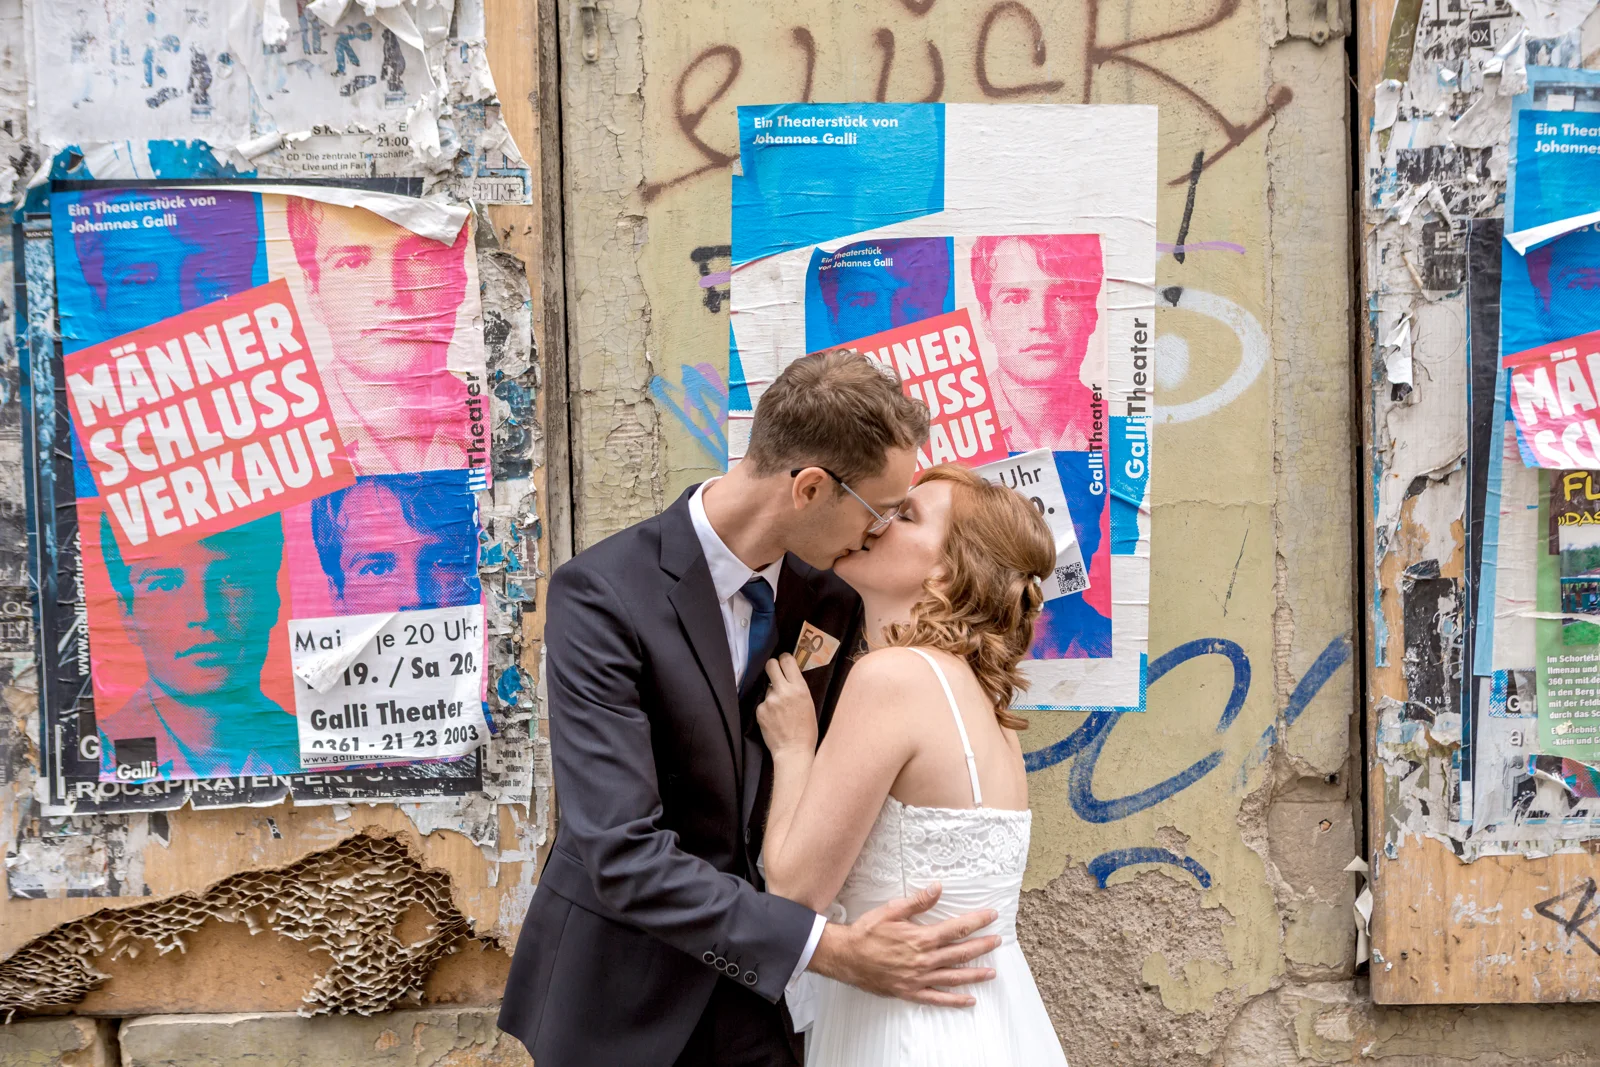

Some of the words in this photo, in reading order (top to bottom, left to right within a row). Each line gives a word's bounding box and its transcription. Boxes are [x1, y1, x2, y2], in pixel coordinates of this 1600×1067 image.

[754, 118, 773, 128] Ein
[777, 115, 868, 128] Theaterstück
[873, 118, 899, 128] von
[1535, 123, 1557, 135] Ein
[377, 137, 409, 147] 21:00
[753, 133, 818, 145] Johannes
[823, 133, 857, 145] Galli
[323, 163, 338, 171] und
[68, 203, 91, 217] Ein
[94, 195, 187, 215] Theaterstück
[189, 195, 217, 208] von
[69, 219, 139, 234] Johannes
[142, 213, 178, 229] Galli
[833, 260, 871, 269] Johannes
[873, 258, 893, 267] Galli
[857, 325, 976, 381] NNER
[66, 302, 302, 427] MÄNNER
[90, 359, 320, 486] SCHLUSS
[106, 418, 336, 546] VERKAUF
[999, 465, 1041, 489] Uhr
[294, 629, 342, 652] Mai
[403, 623, 435, 646] 20
[444, 618, 478, 642] Uhr
[411, 657, 440, 679] Sa
[449, 652, 477, 676] 20.
[1547, 655, 1558, 663] Im
[1582, 665, 1598, 673] und
[1548, 677, 1563, 685] 360
[1575, 676, 1589, 684] mit
[1548, 689, 1556, 697] in
[1558, 688, 1573, 696] den
[1575, 688, 1595, 698] Berg
[1549, 700, 1562, 708] mit
[1563, 699, 1578, 707] der
[310, 703, 368, 731] Galli
[376, 699, 463, 726] Theater
[1549, 711, 1572, 719] durch
[1574, 710, 1589, 718] das
[382, 732, 403, 751] 21
[413, 729, 438, 748] 23
[444, 724, 479, 745] 2003
[116, 760, 157, 780] Galli
